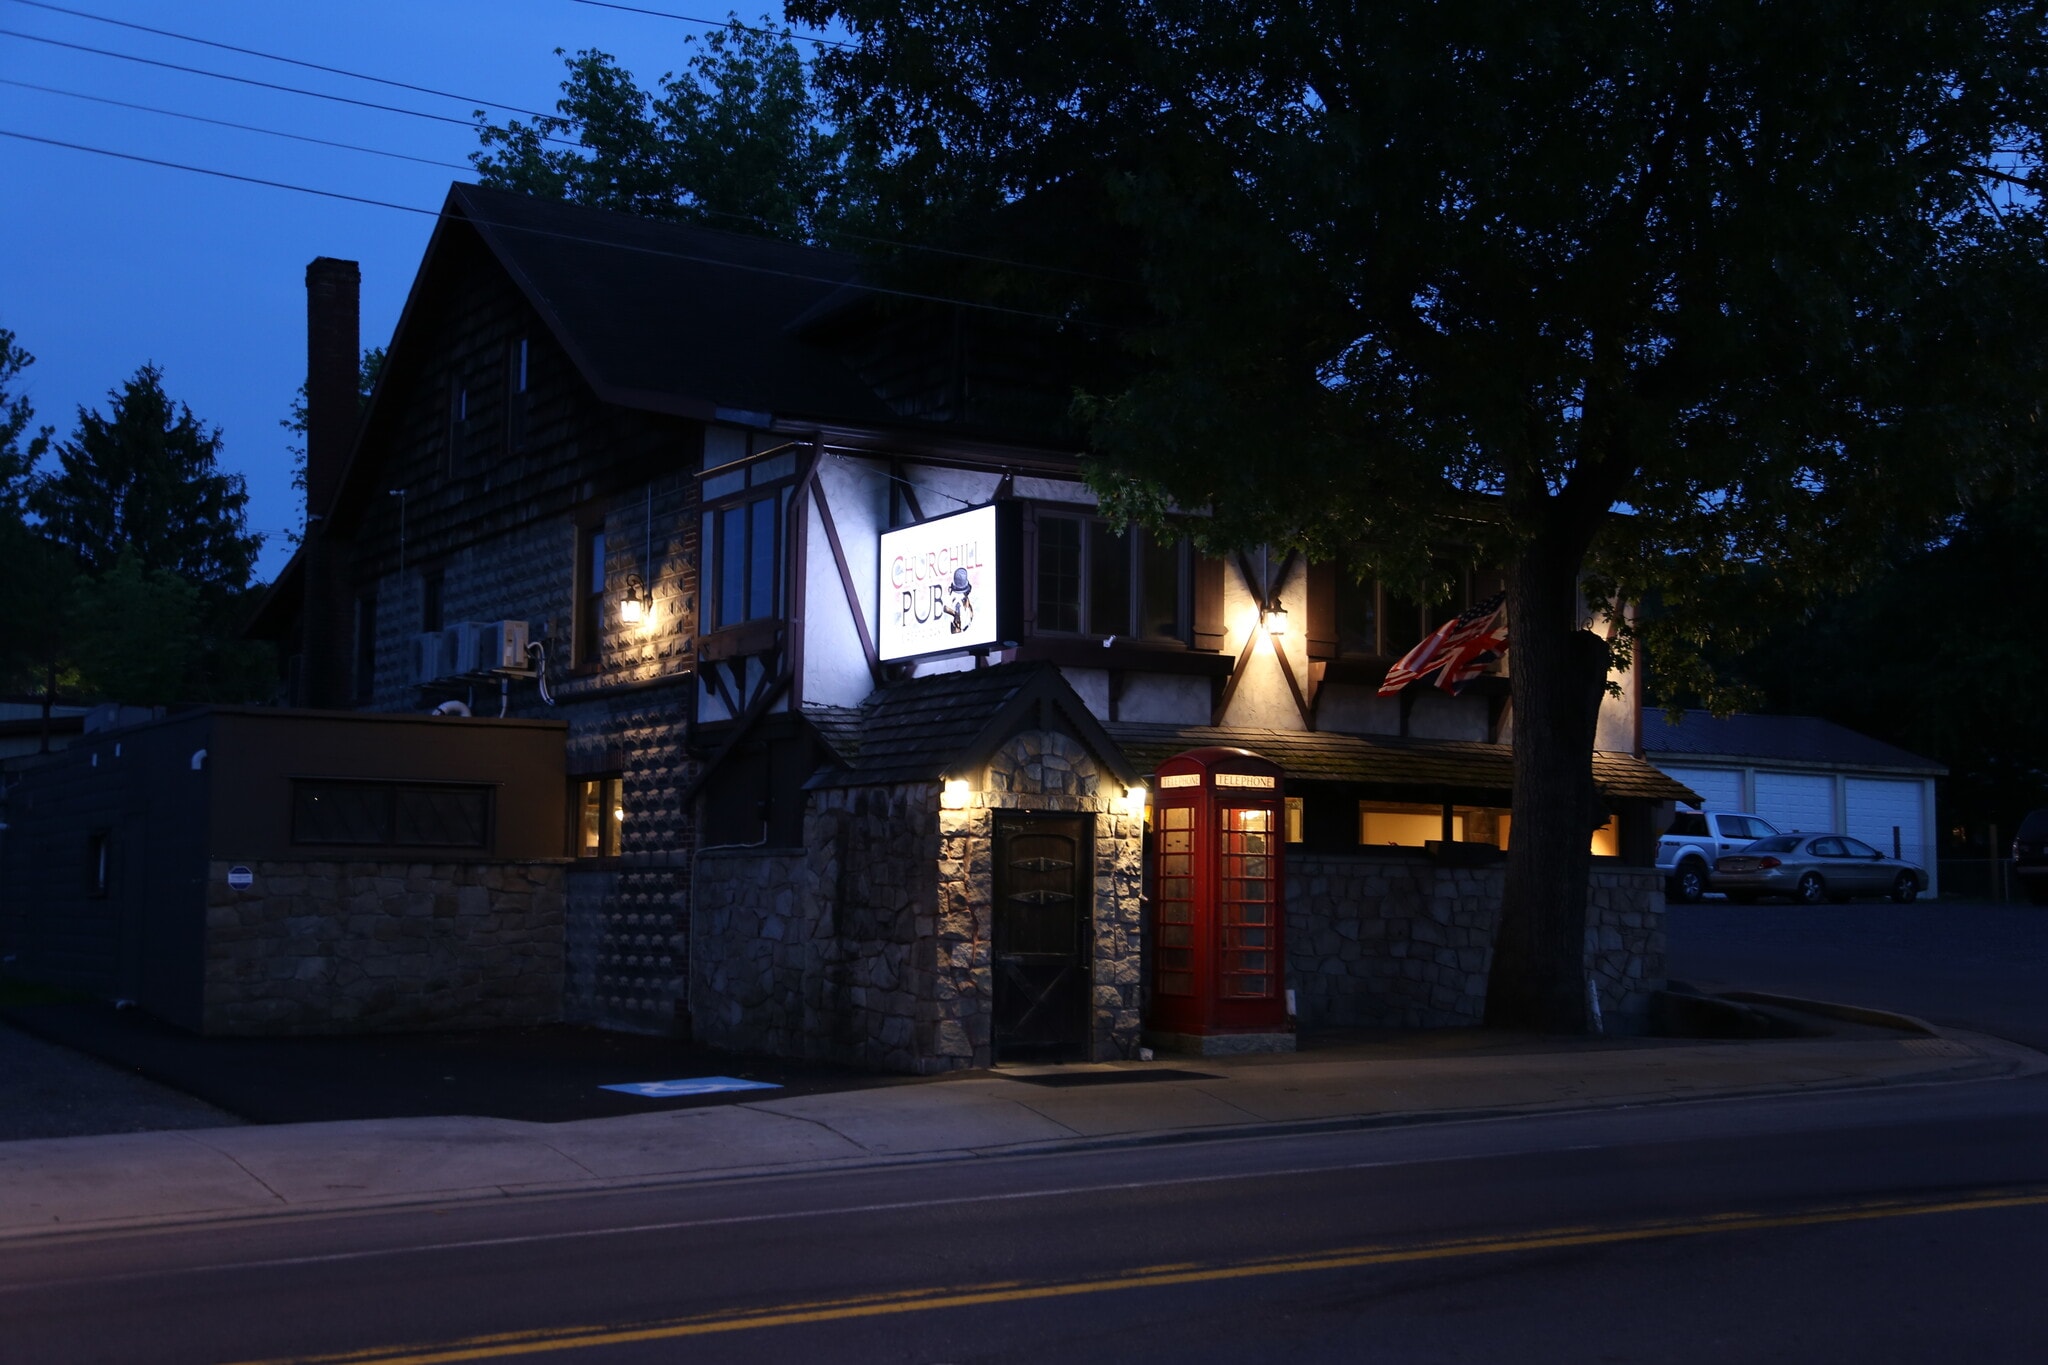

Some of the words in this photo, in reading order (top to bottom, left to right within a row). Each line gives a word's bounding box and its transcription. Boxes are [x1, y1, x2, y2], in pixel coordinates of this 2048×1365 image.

[891, 541, 983, 590] CHURCHILL
[902, 584, 943, 627] PUB
[1163, 775, 1199, 787] TELEPHONE
[1218, 775, 1272, 787] TELEPHONE
